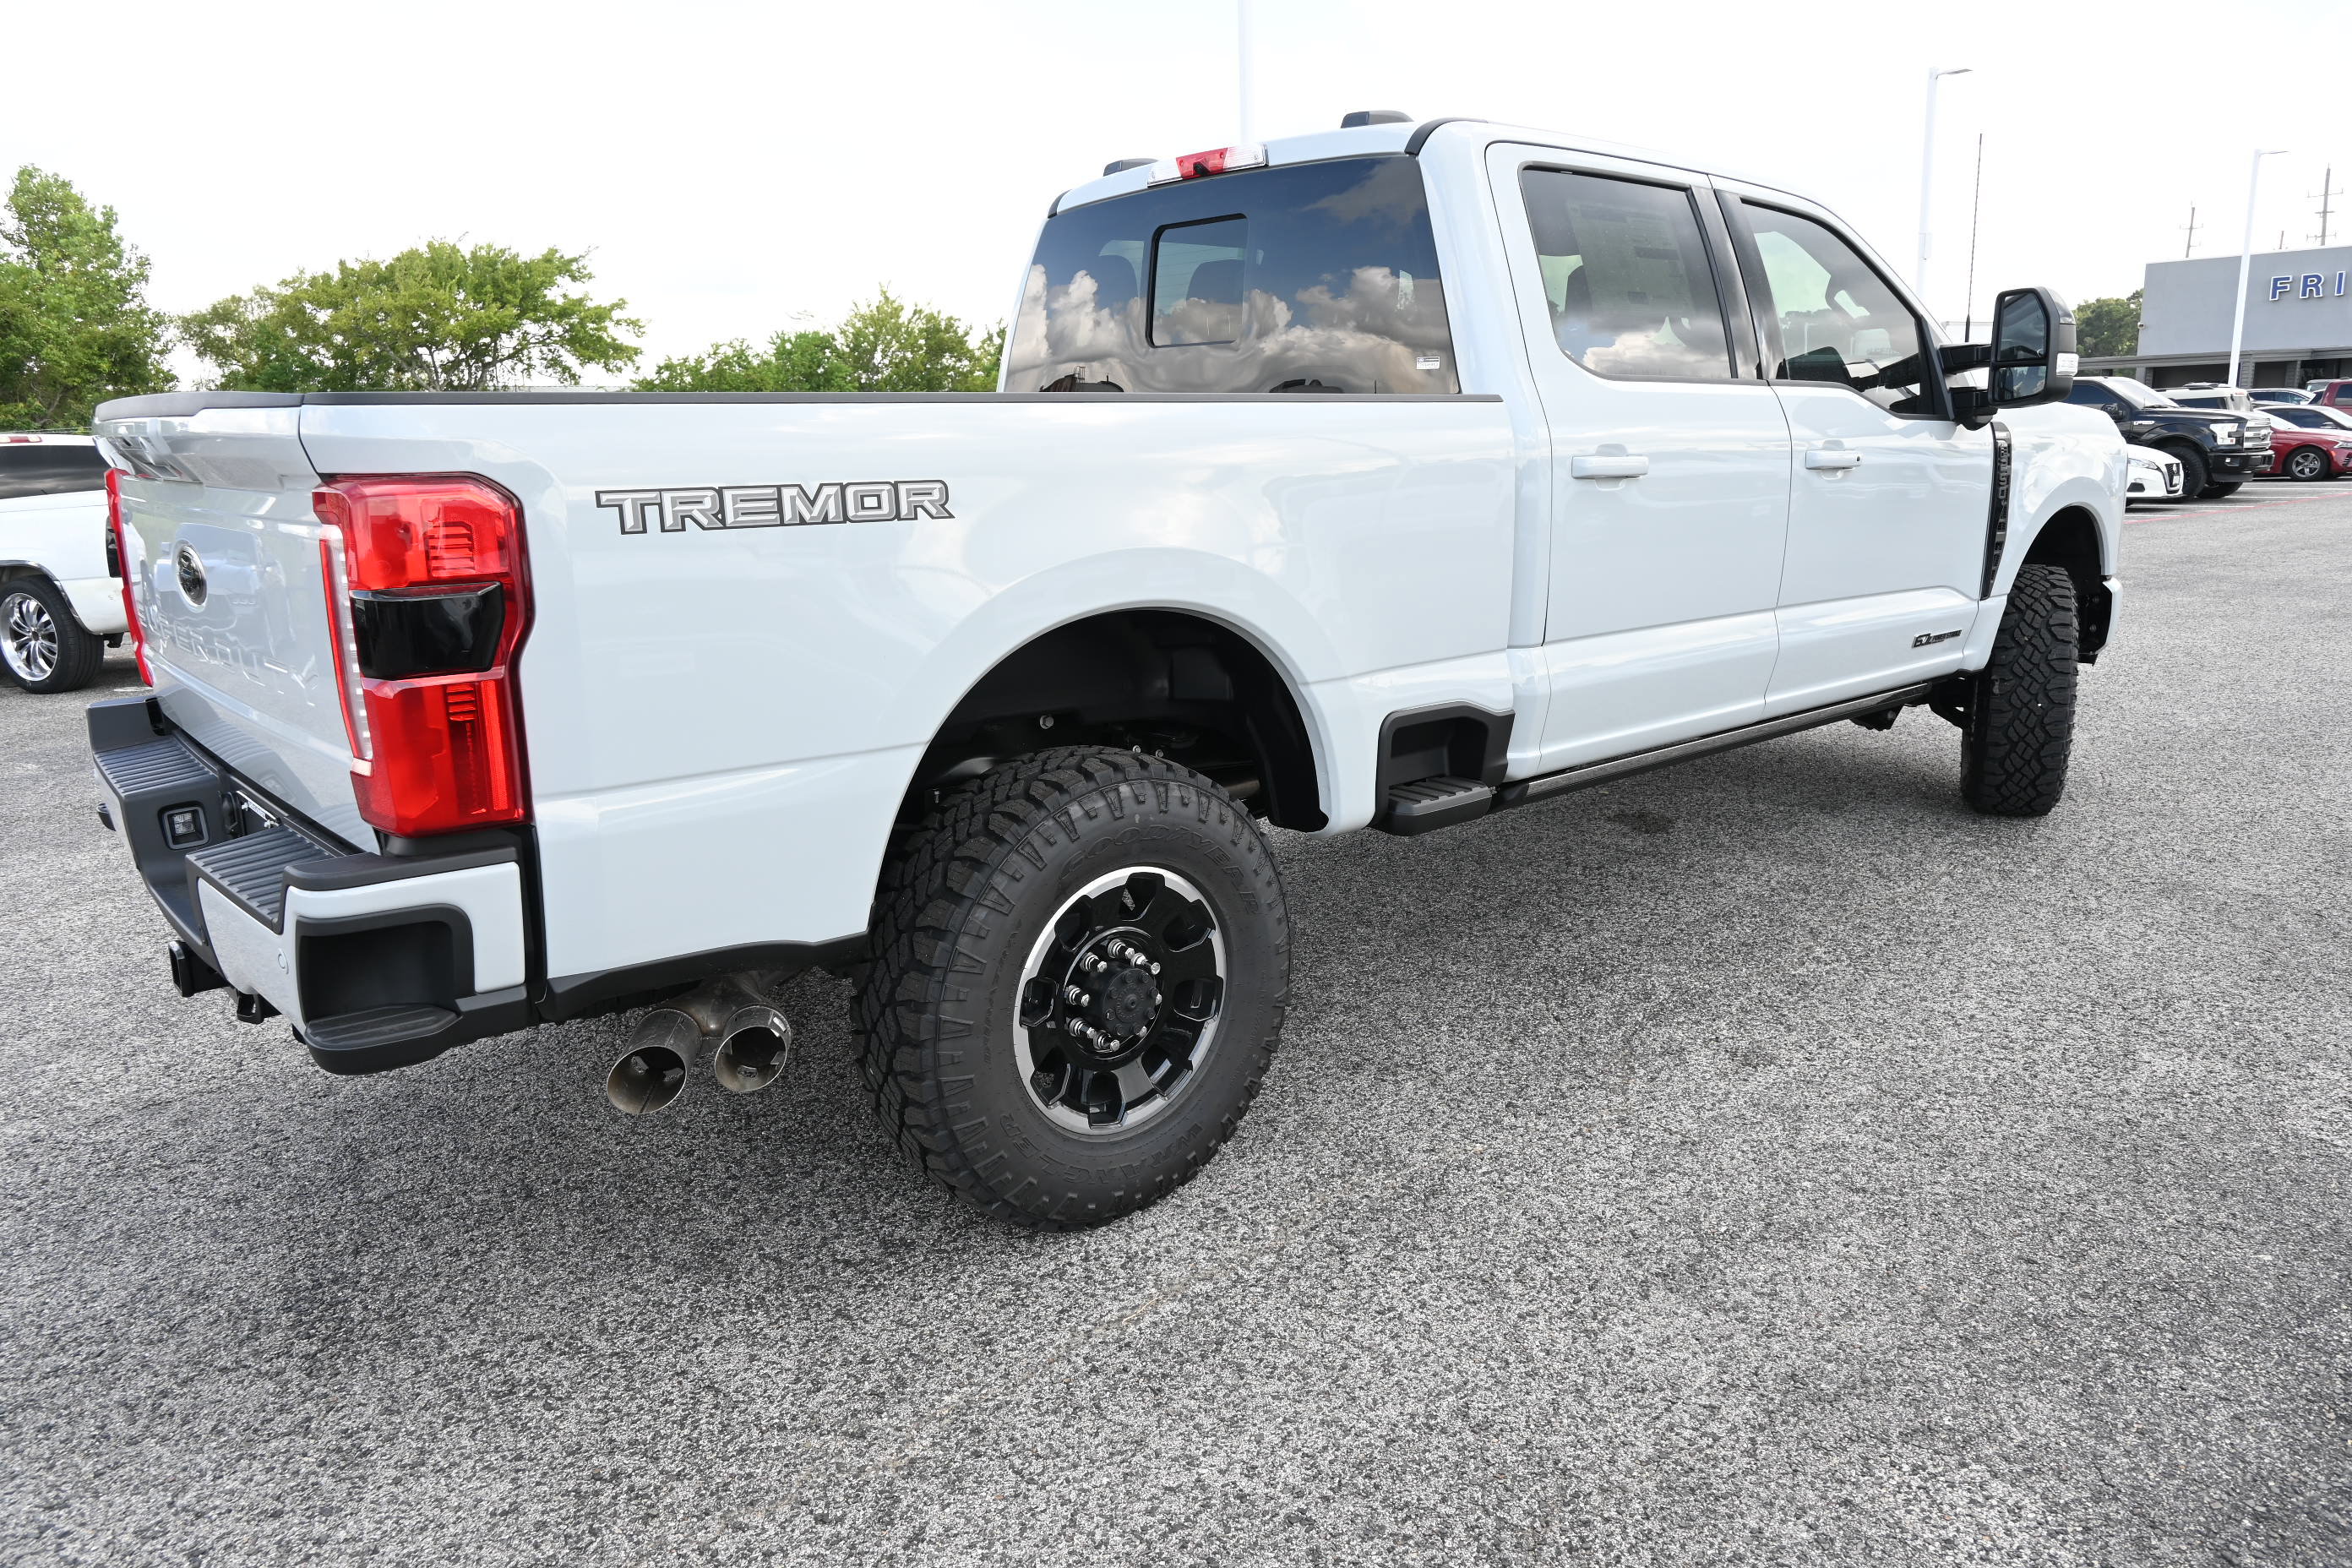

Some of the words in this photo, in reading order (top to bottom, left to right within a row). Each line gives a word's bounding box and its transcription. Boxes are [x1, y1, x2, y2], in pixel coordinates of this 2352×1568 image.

[2269, 271, 2346, 301] FRI
[595, 479, 956, 535] TREMOR
[1000, 1114, 1203, 1184] WRANGLER
